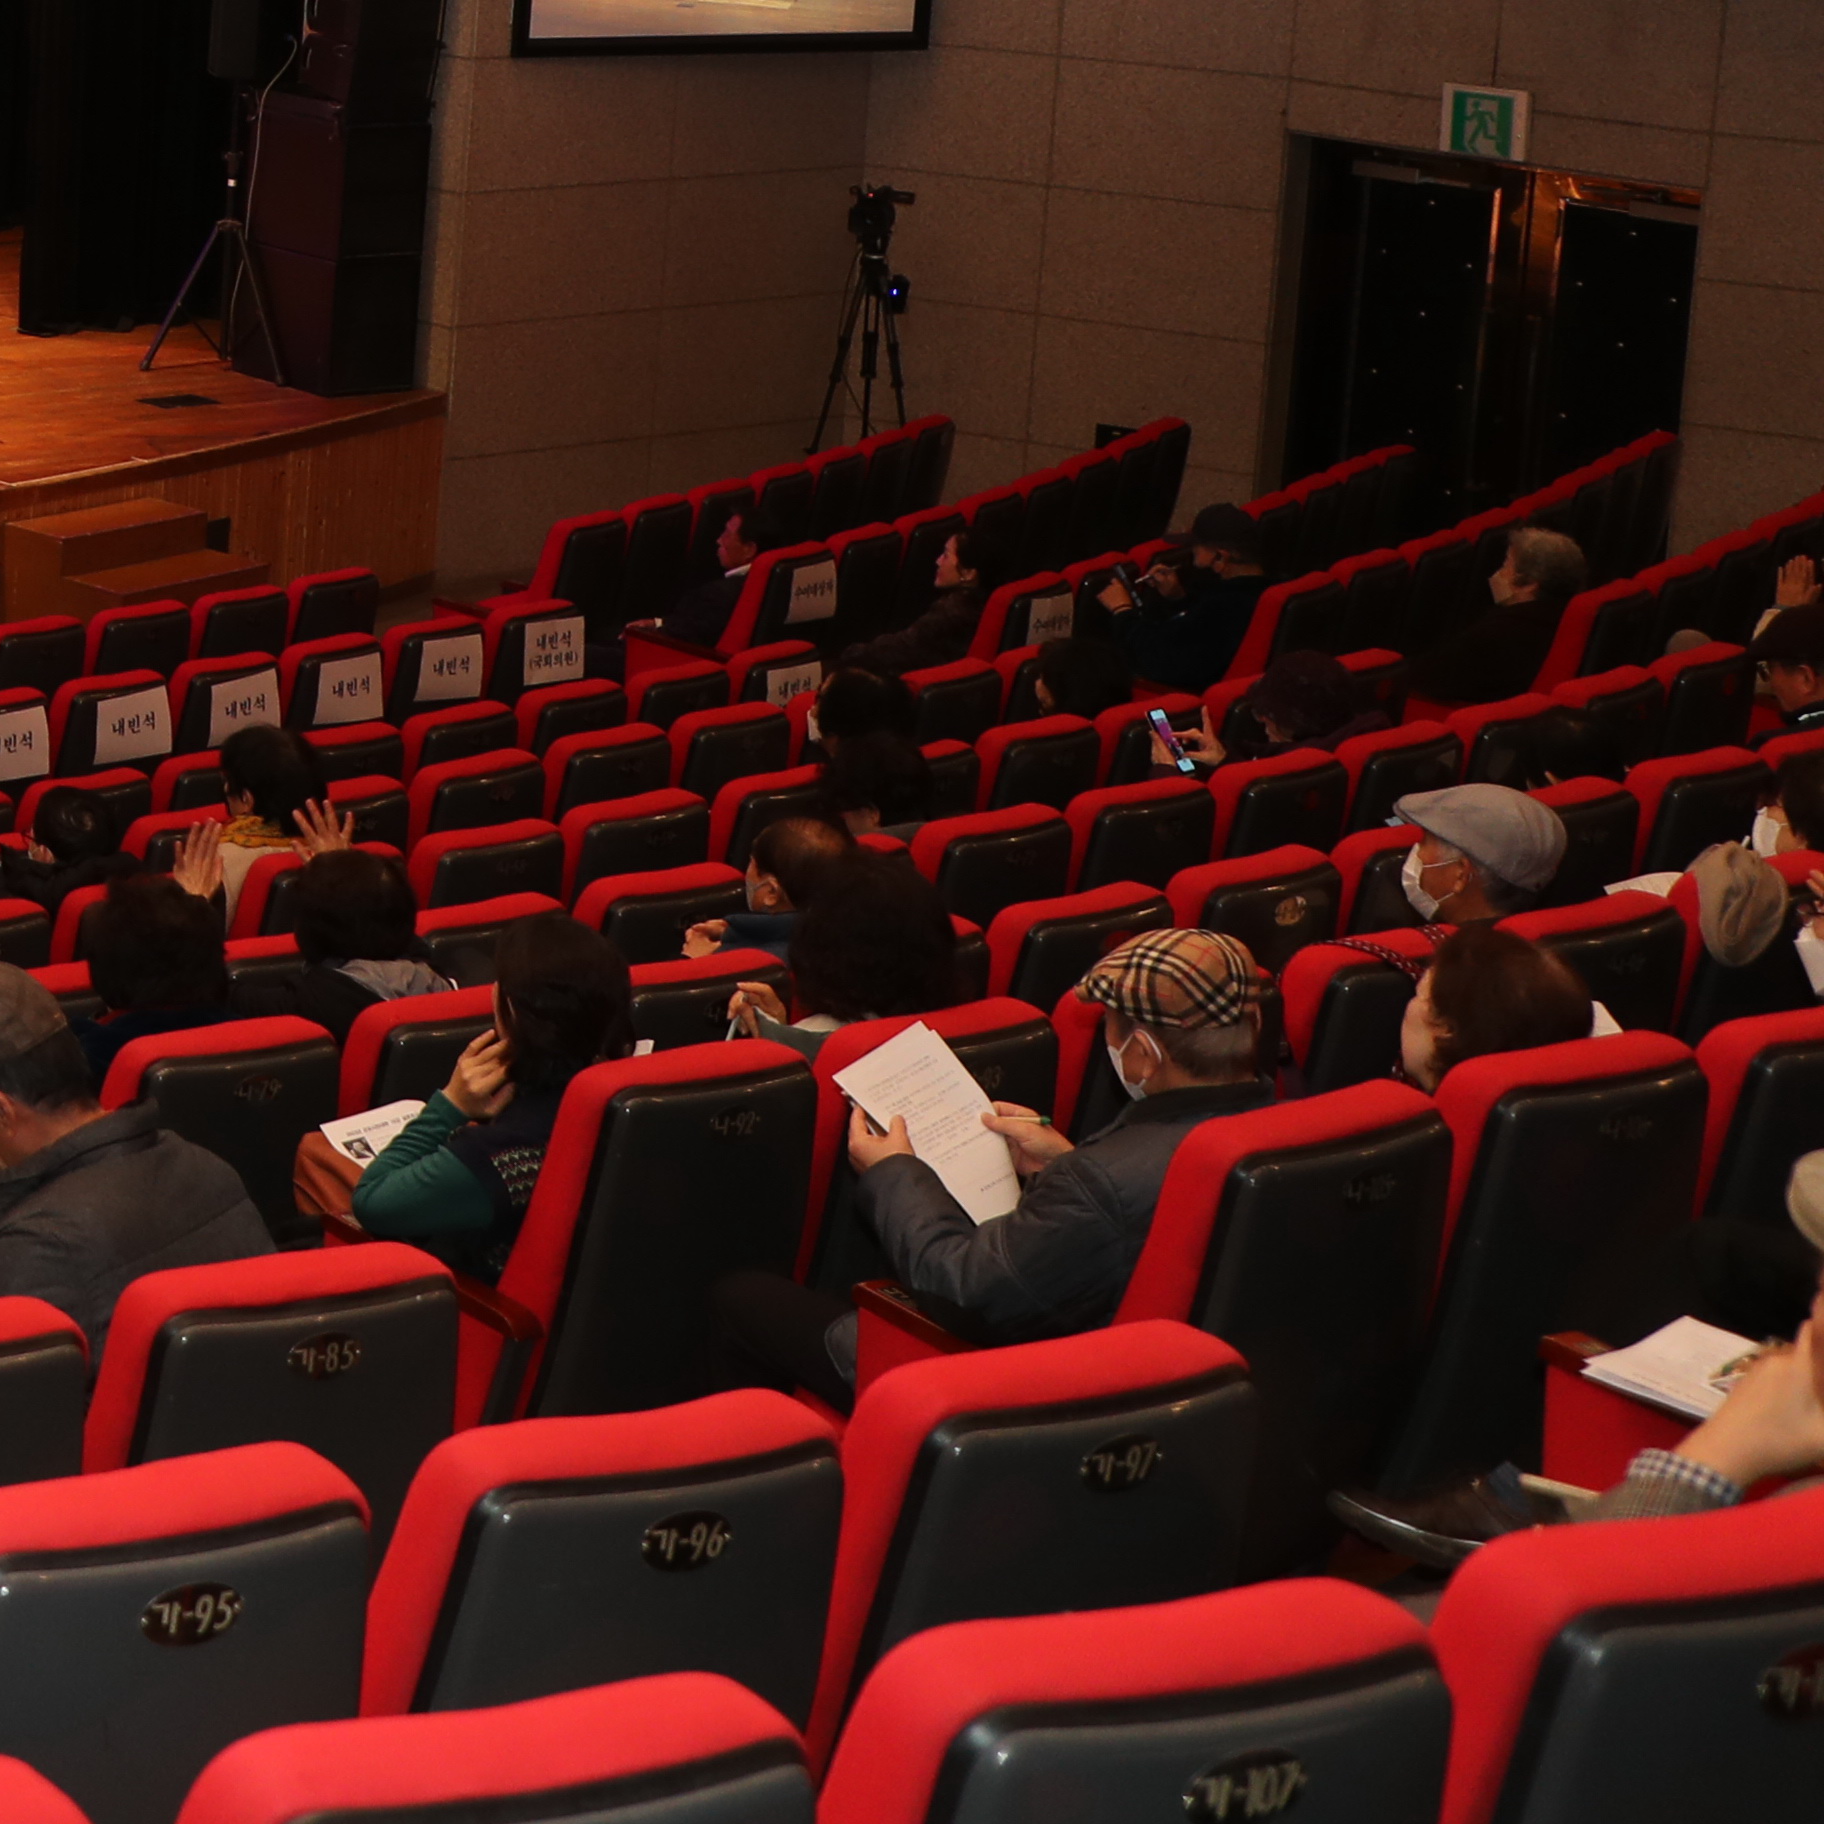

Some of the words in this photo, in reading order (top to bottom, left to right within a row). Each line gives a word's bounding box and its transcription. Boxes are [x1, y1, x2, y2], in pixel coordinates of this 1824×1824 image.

[536, 630, 573, 651] 내빈석
[433, 655, 471, 677] 내빈석
[332, 676, 371, 698] 내빈석
[225, 694, 267, 718] 내빈석
[111, 711, 156, 736] 내빈석
[297, 1343, 352, 1373] 가-85
[1091, 1442, 1157, 1482] 가-97
[654, 1521, 724, 1562] 가-96
[153, 1590, 236, 1635] 가-95
